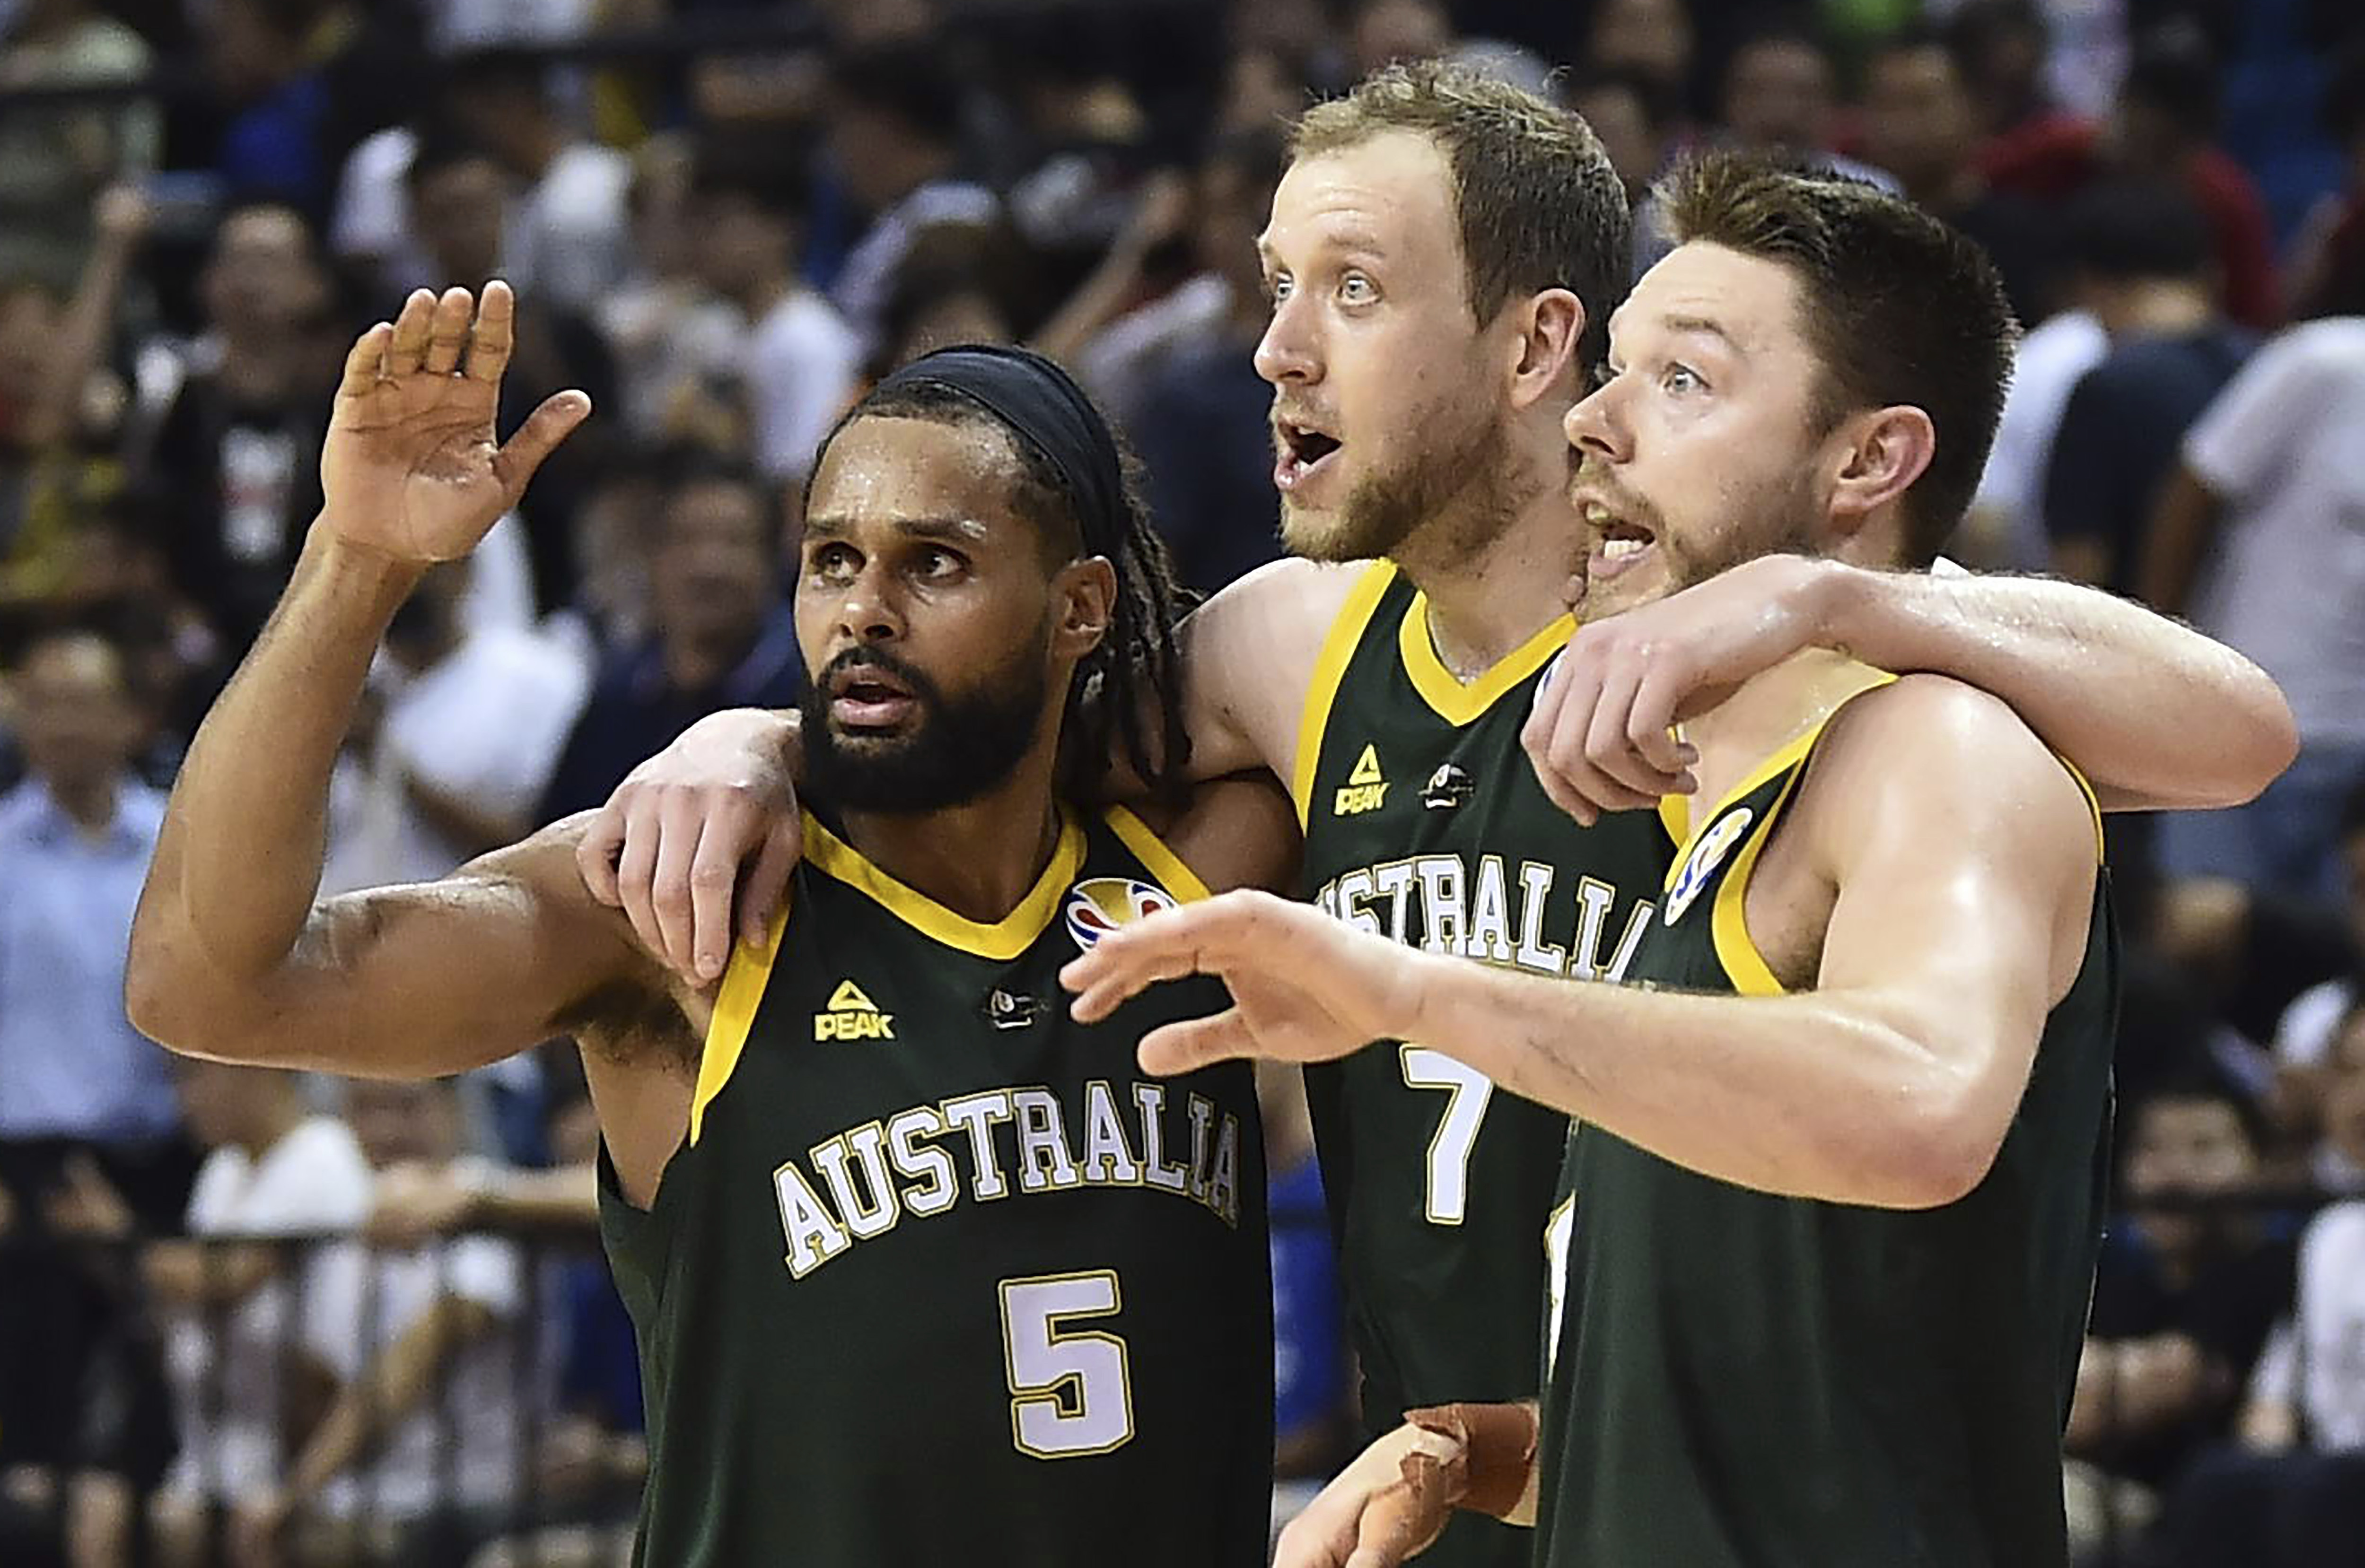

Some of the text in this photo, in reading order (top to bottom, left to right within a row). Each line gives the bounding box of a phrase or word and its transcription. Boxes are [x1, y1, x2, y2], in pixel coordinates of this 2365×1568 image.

[1314, 854, 1656, 983] STRALI
[815, 1013, 895, 1041] PEAK
[773, 1080, 1239, 1281] AUSTRALIA
[1399, 1043, 1493, 1225] 7
[998, 1269, 1134, 1459] 5
